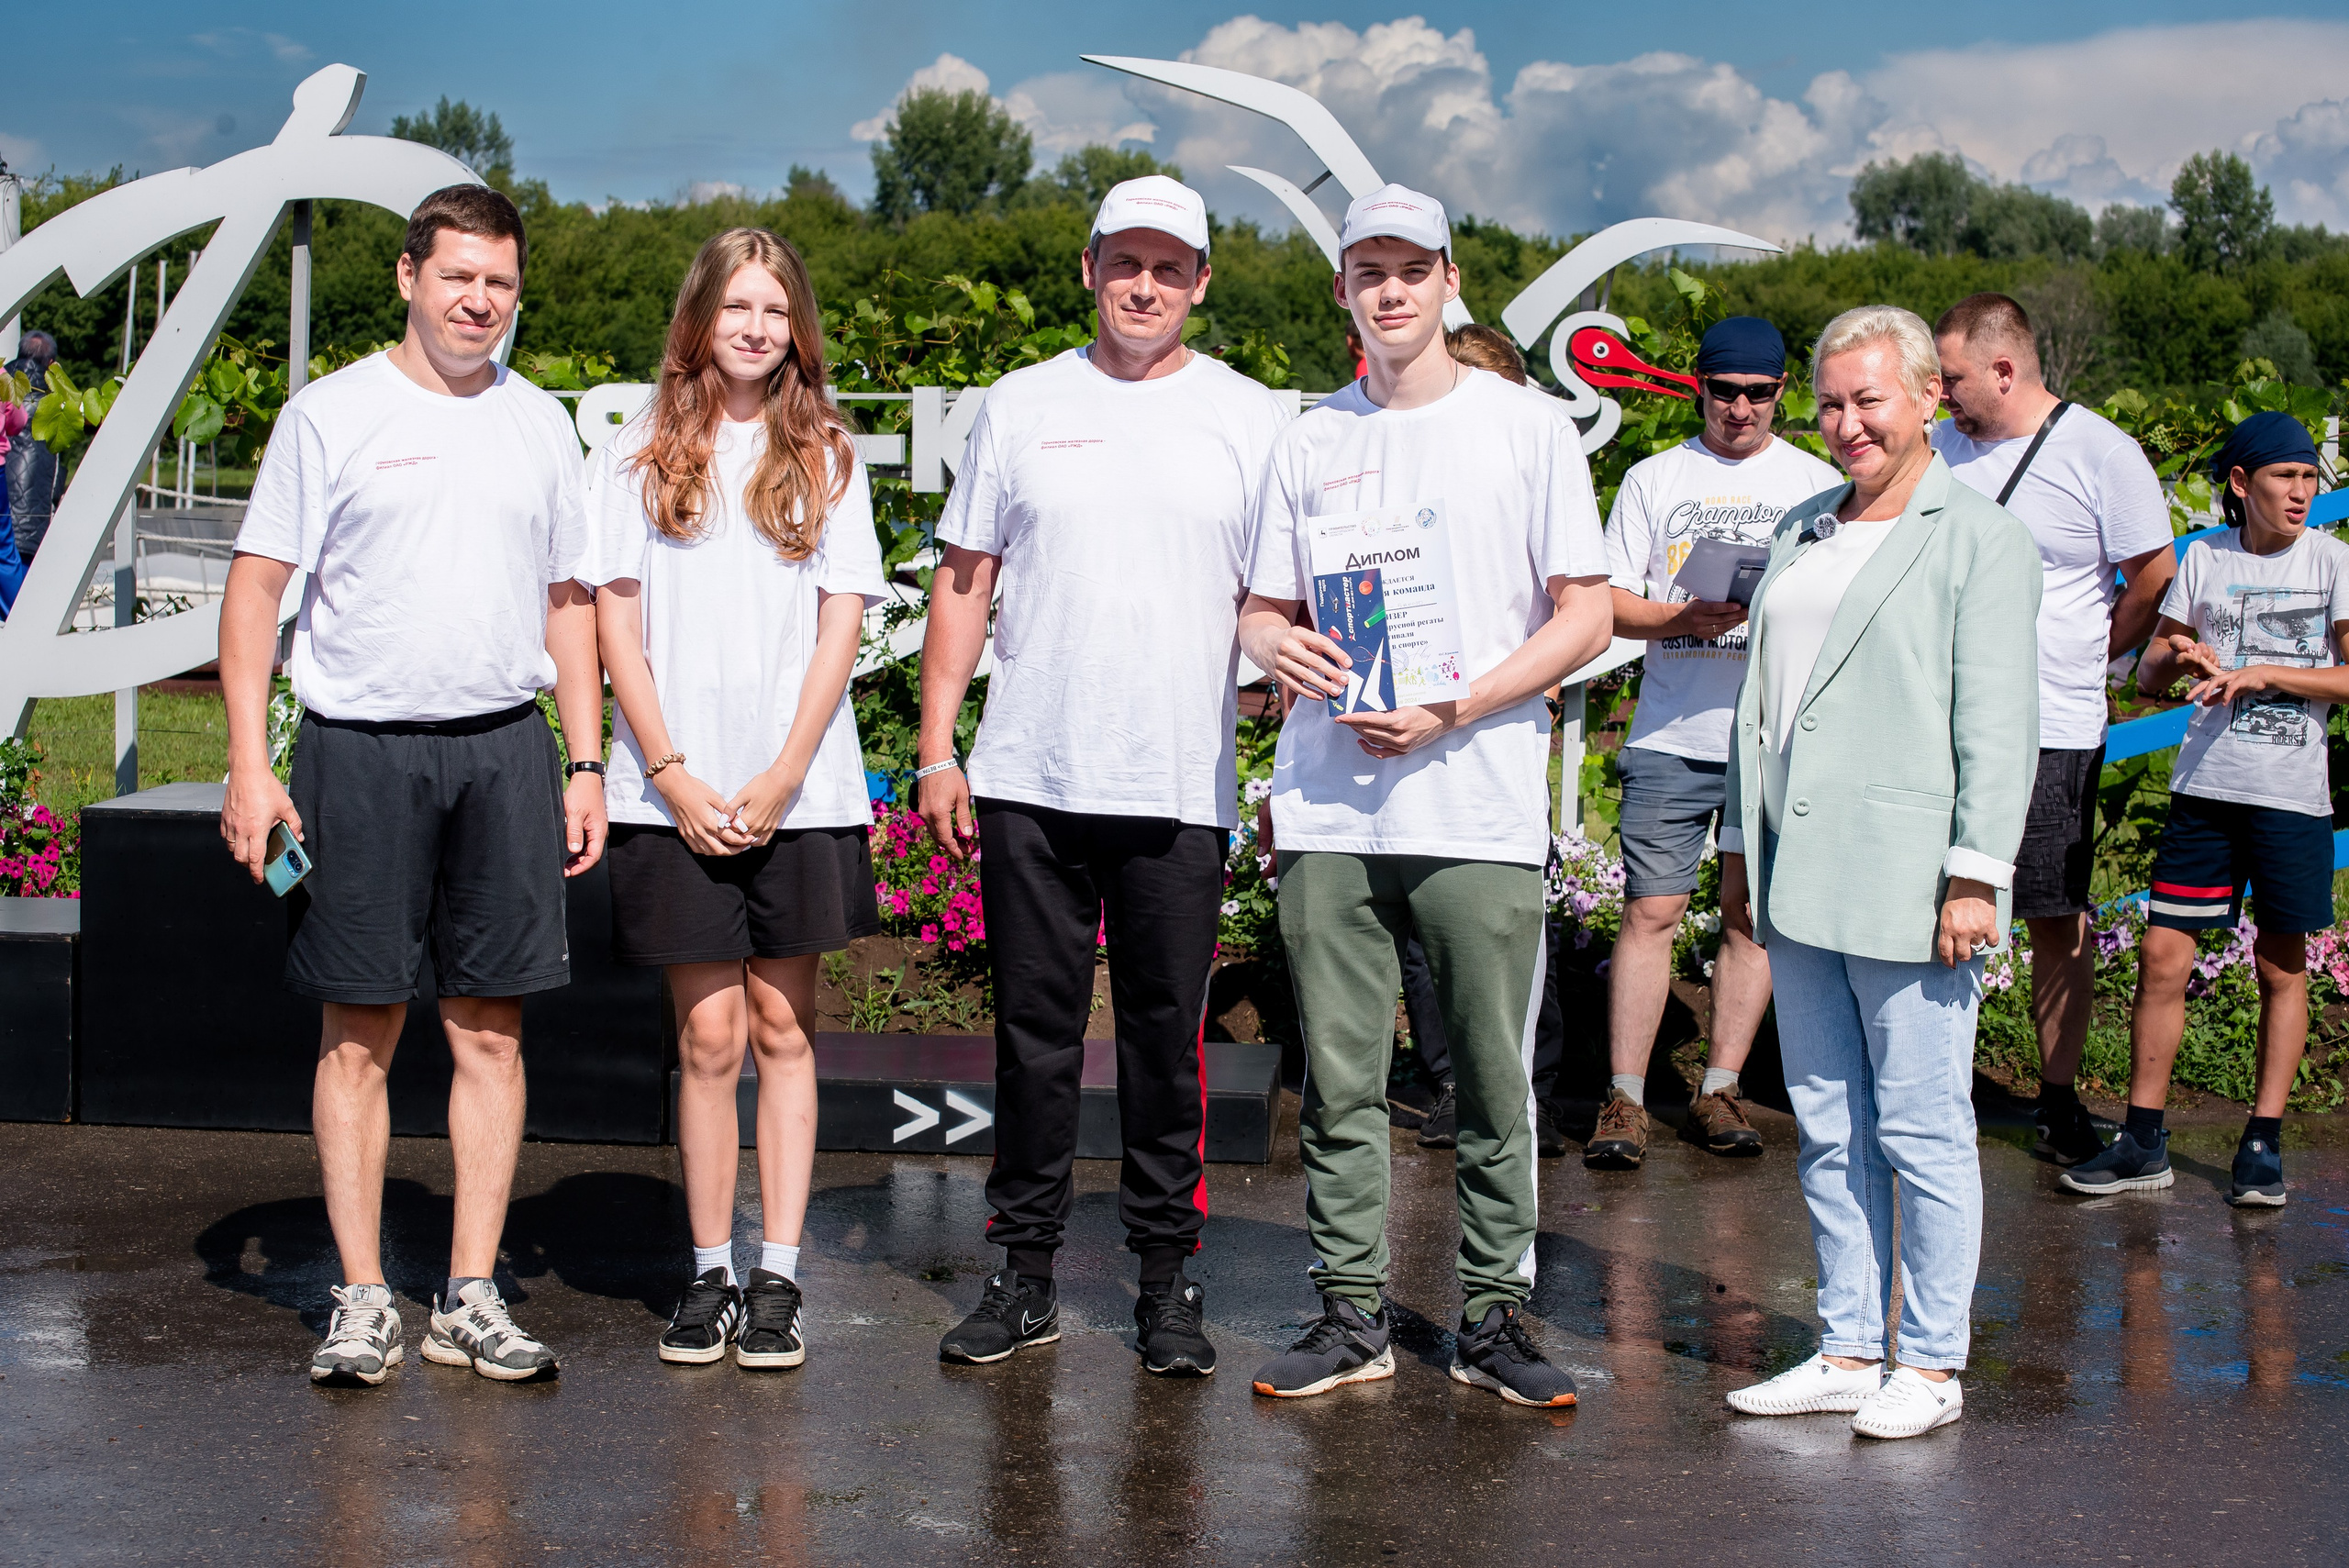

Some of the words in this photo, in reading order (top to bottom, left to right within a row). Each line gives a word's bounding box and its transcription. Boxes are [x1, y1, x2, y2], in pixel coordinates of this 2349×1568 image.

[1705, 496, 1727, 506] ROAD
[1731, 495, 1752, 505] RACE
[1393, 583, 1436, 596] команда
[1341, 576, 1354, 634] спортмастер
[1388, 620, 1416, 632] русной
[1417, 617, 1444, 628] регаты
[1398, 639, 1429, 650] спорте»
[1662, 634, 1704, 650] CUSTOM
[1663, 650, 1722, 660] EXTRAORDINARY
[1726, 652, 1748, 661] PERF
